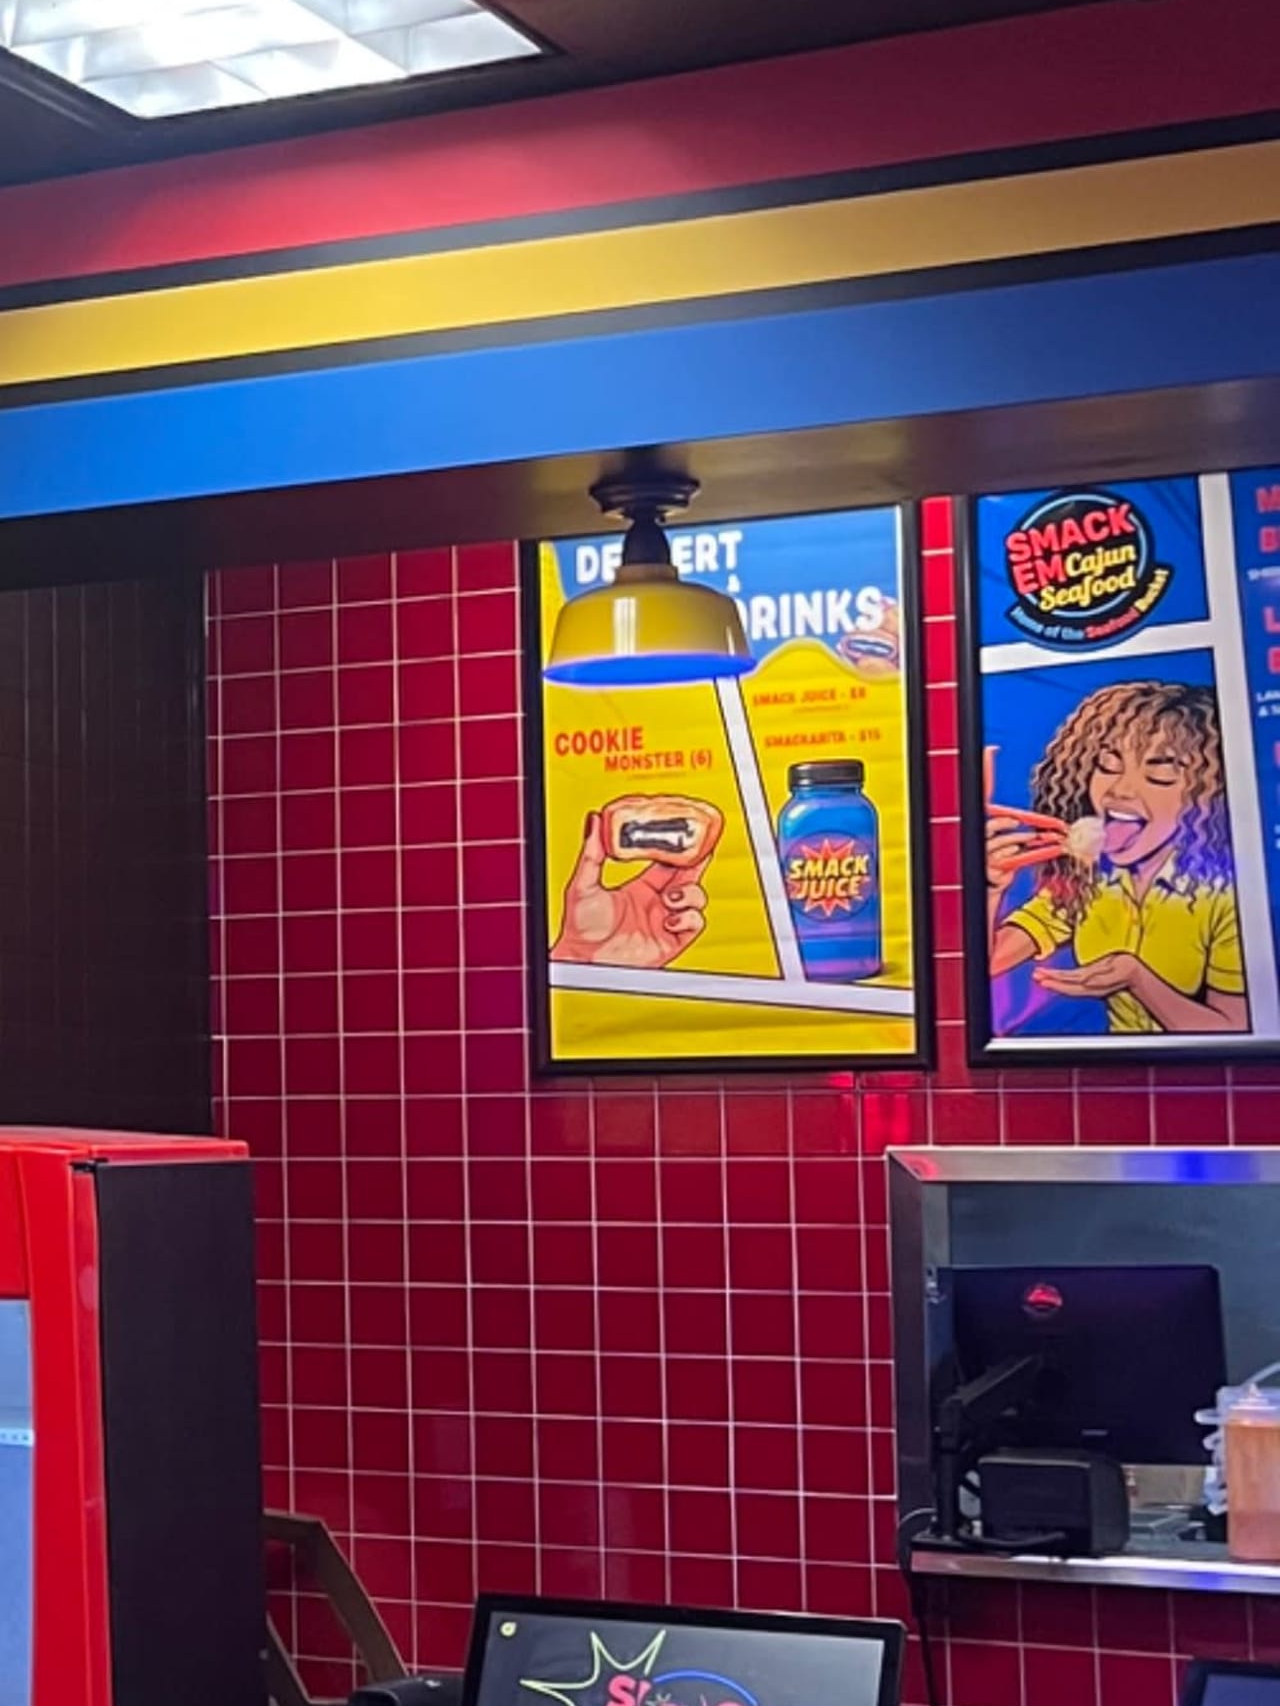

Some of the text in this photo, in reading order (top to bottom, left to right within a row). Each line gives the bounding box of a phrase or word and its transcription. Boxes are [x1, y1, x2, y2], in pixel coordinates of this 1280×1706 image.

[1006, 503, 1135, 562] SMACK
[576, 531, 742, 584] DEERT
[1013, 544, 1137, 594] EM Cajun
[1040, 565, 1137, 611] Seafood
[555, 727, 644, 757] COOKIE
[605, 750, 712, 773] MONSTER (6)
[790, 854, 869, 879] SMACK
[794, 875, 860, 899] JUICE
